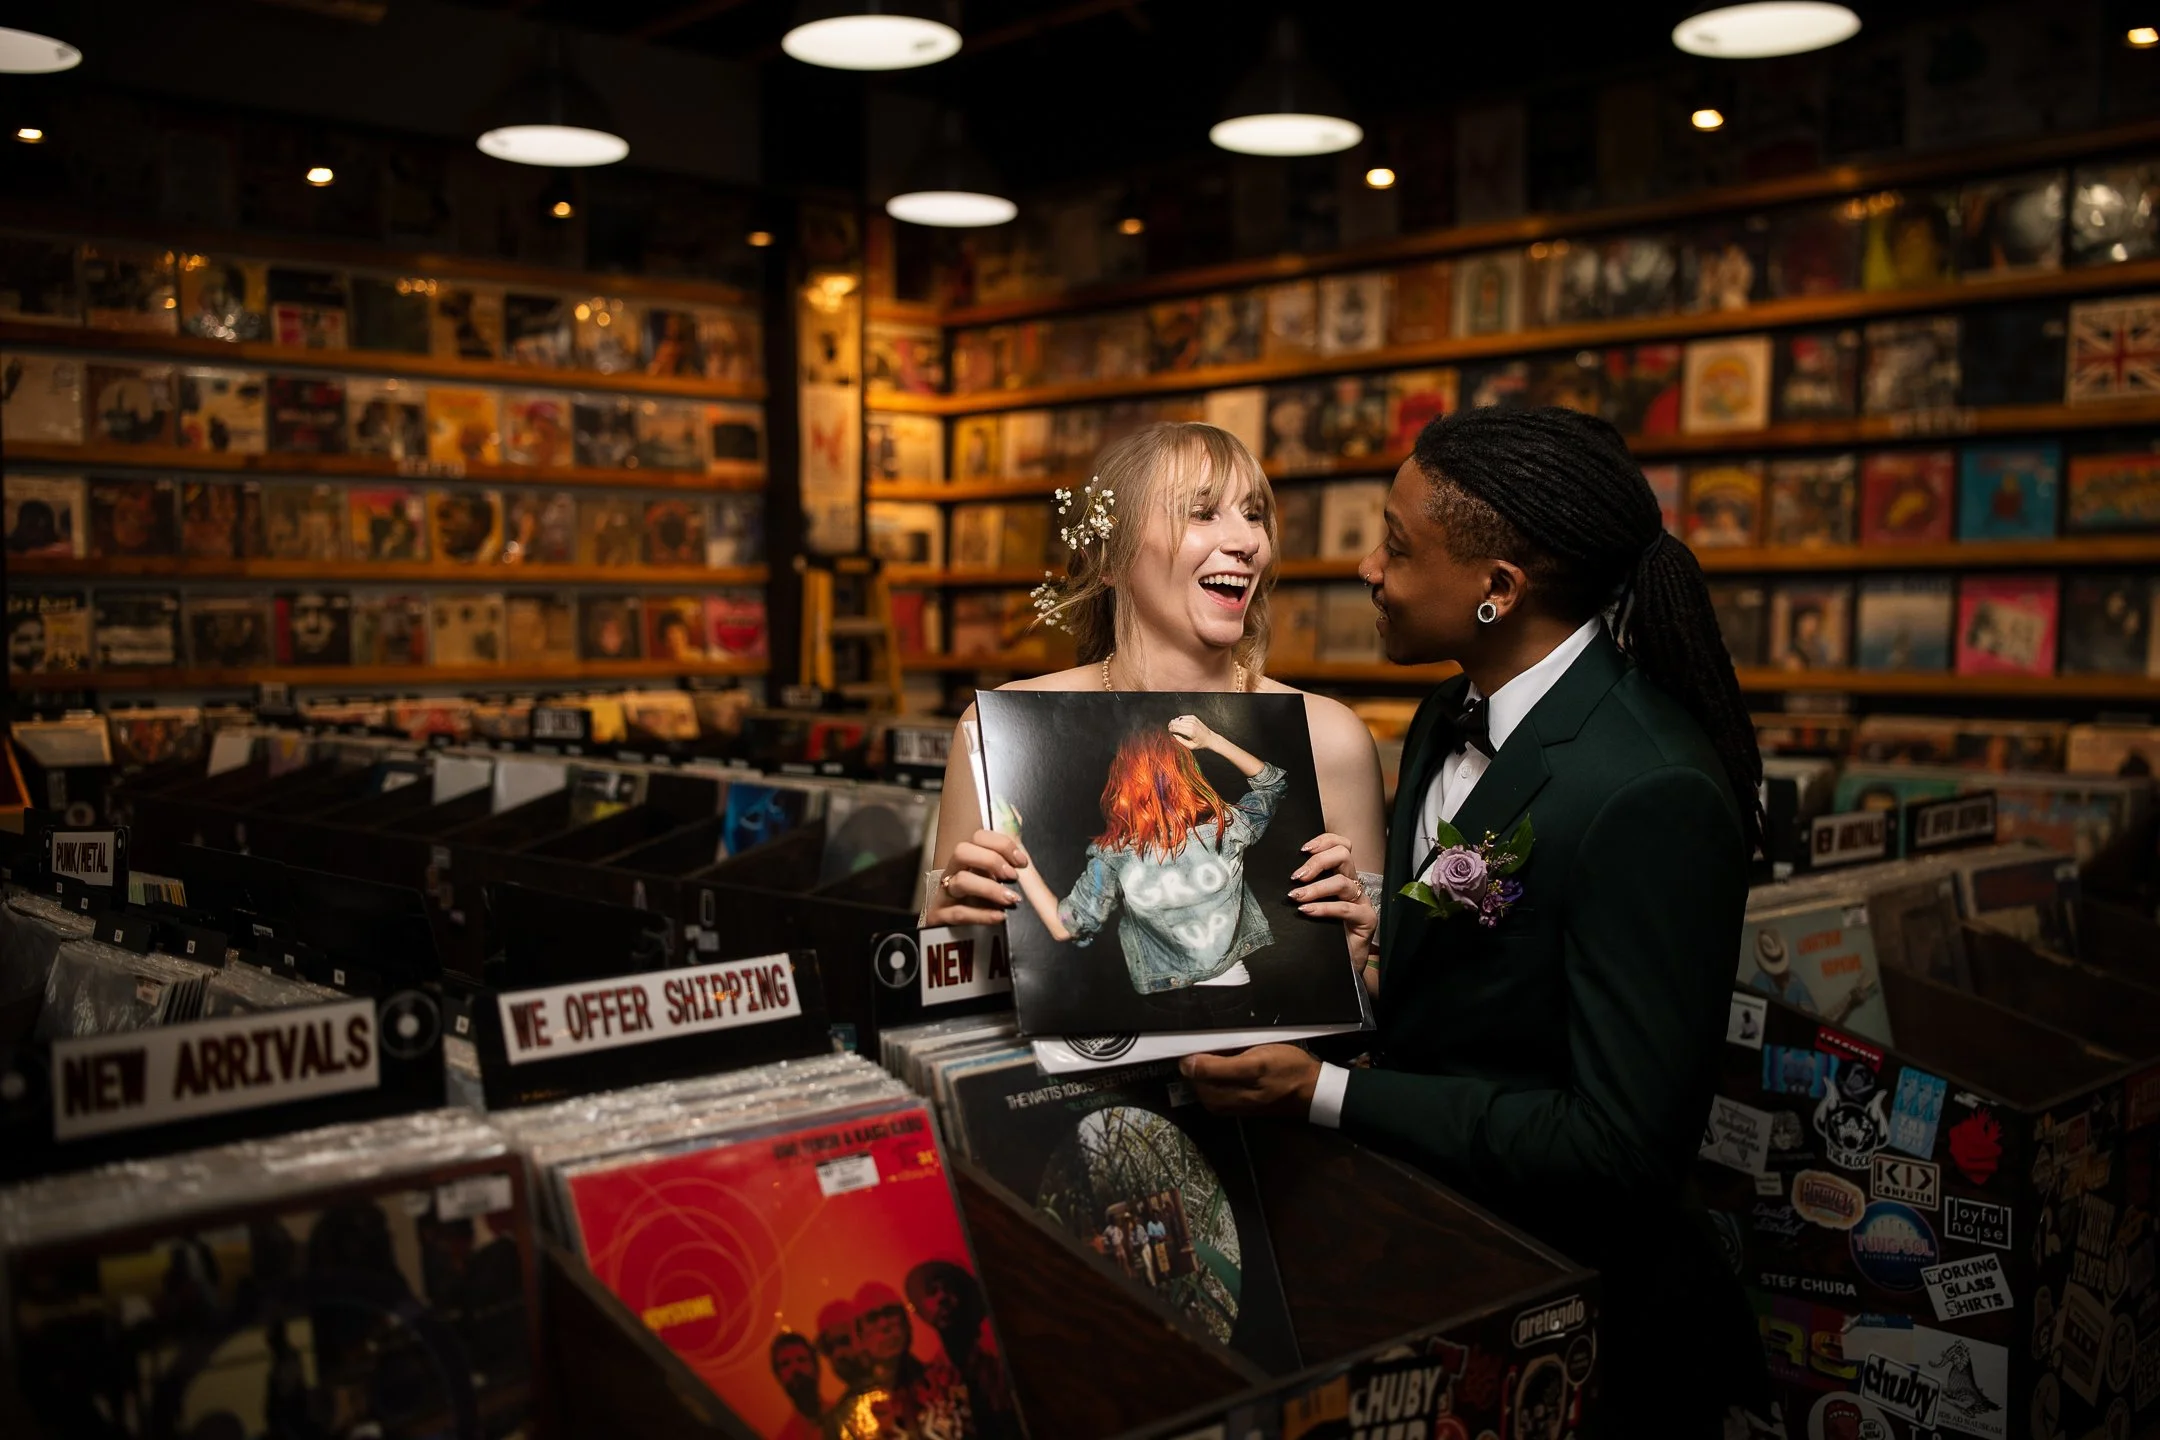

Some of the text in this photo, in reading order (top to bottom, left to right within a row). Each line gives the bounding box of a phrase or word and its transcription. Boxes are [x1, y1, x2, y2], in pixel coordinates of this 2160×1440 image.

[56, 842, 108, 874] PUNK/METAL
[1173, 913, 1228, 948] UP
[927, 940, 974, 989] NEW
[510, 964, 791, 1051] WE OFFER SHIPPING
[64, 1016, 370, 1117] NEW ARRIVALS
[1005, 1091, 1029, 1110] THE
[1028, 1085, 1063, 1106] WATTS
[1876, 1184, 1933, 1204] COMPUTER
[1760, 1272, 1858, 1298] STEF CHURA
[1926, 1259, 1999, 1286] WORKING
[1941, 1276, 1996, 1299] CLASS
[1945, 1293, 2005, 1317] SHIRTS
[1349, 1365, 1444, 1429] CHUBY
